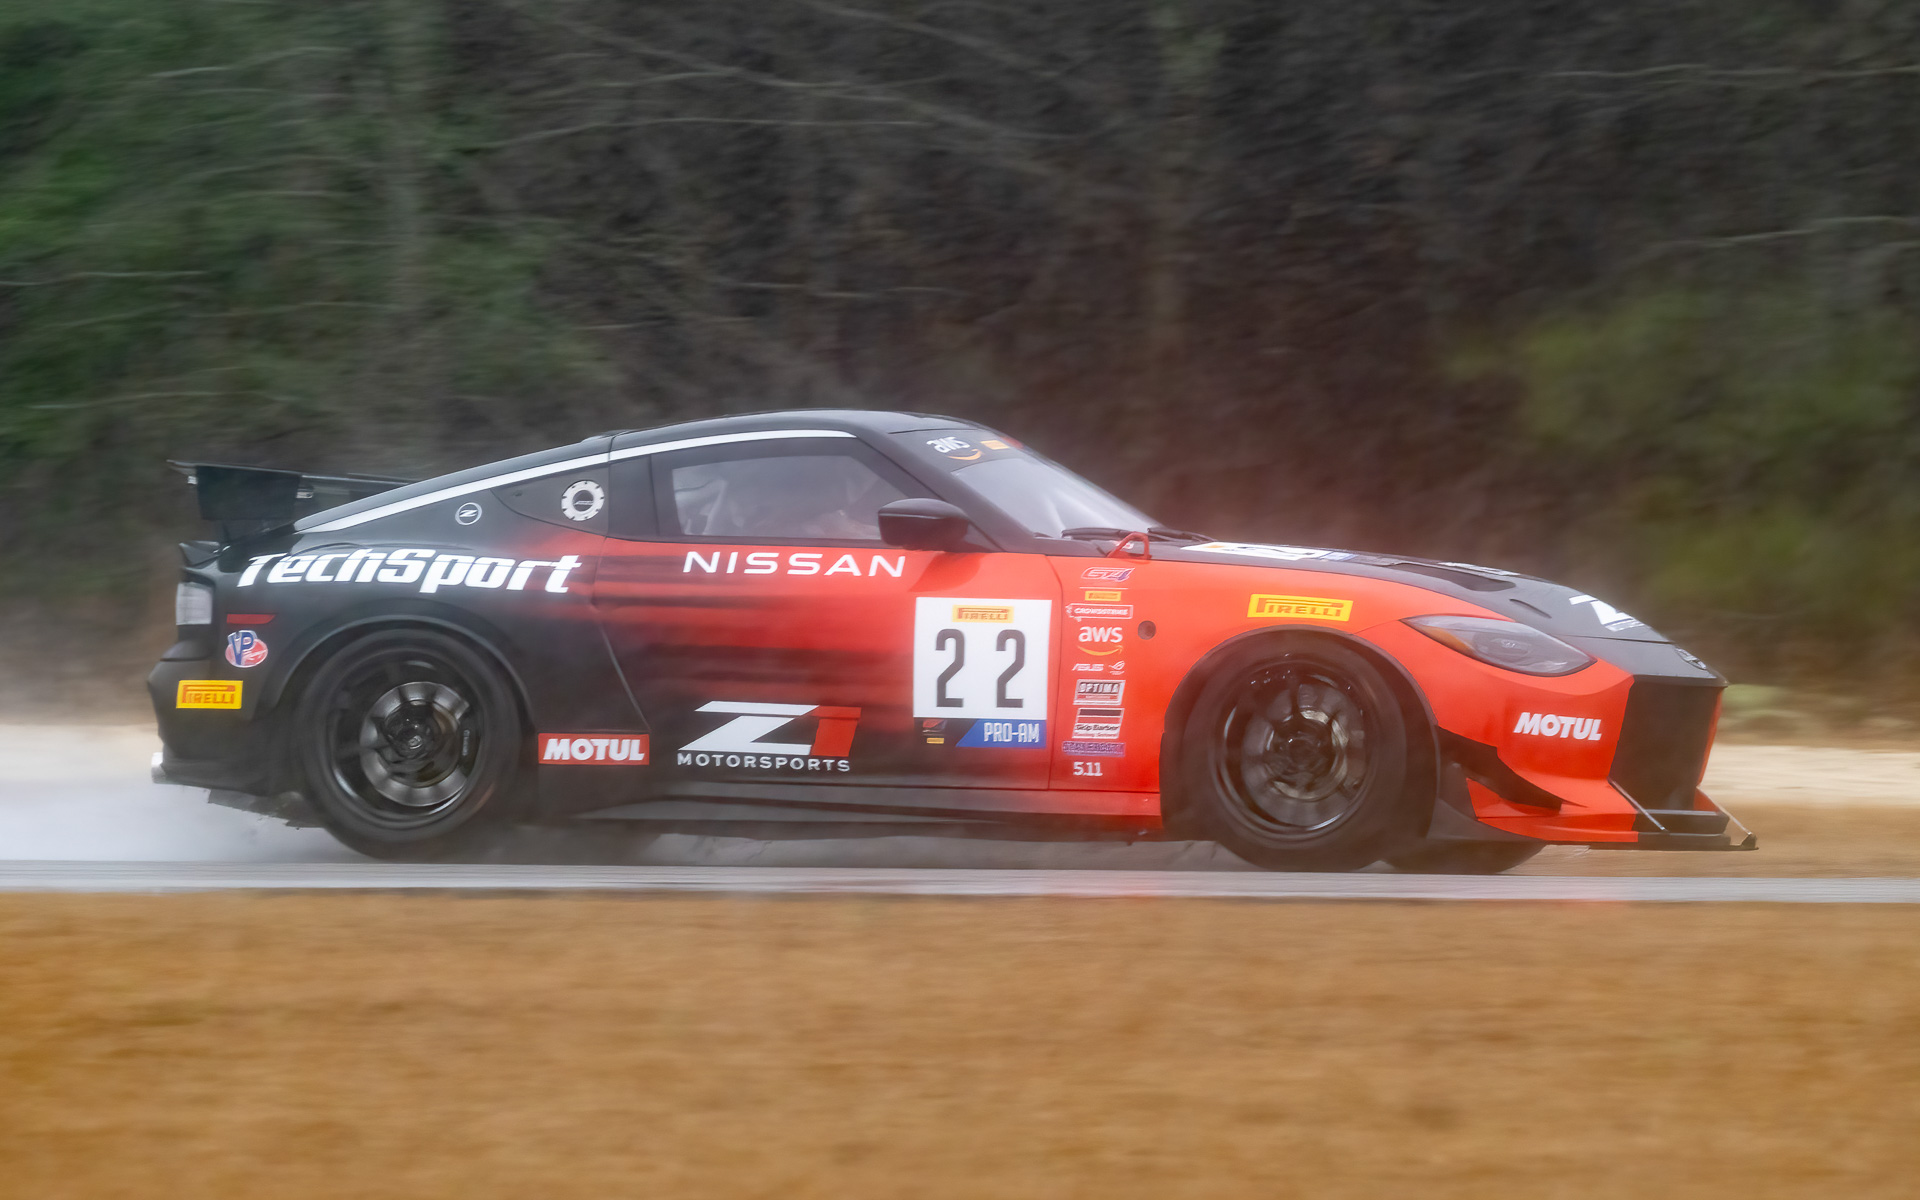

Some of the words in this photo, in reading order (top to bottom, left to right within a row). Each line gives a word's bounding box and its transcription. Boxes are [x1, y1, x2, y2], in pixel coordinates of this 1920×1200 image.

[236, 548, 582, 594] TechSport
[683, 551, 905, 578] NISSAN
[957, 607, 1010, 620] PIRELLI
[1256, 597, 1344, 617] PIRELLI
[1078, 626, 1123, 643] aws
[1072, 663, 1104, 671] ASUS
[182, 685, 236, 704] PIRELLI
[1079, 683, 1120, 693] OPTIMA
[678, 701, 862, 757] Z1
[983, 722, 1040, 743] PRO-AM
[1513, 712, 1602, 741] MOTUL
[543, 738, 645, 761] MOTUL
[677, 753, 850, 772] MOTORSPORTS
